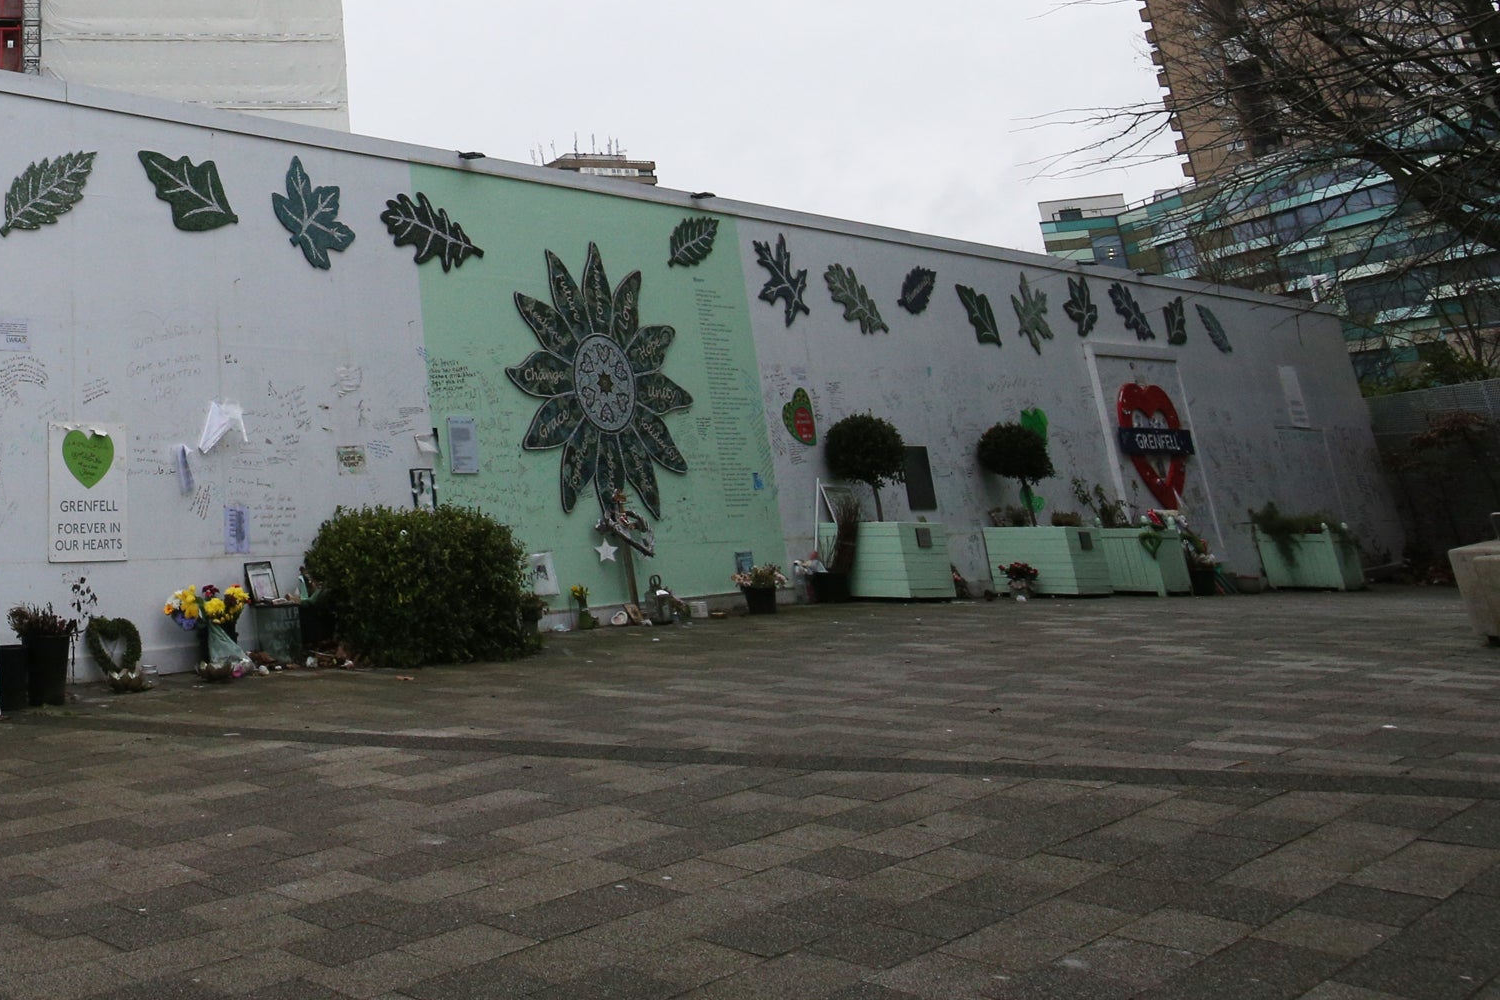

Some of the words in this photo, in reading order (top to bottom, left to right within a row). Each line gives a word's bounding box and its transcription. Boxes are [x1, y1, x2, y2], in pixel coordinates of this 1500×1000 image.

[555, 273, 582, 322] Future
[593, 264, 606, 324] Forever
[619, 290, 635, 331] Love
[639, 338, 662, 360] Hope
[524, 368, 565, 385] Change
[647, 386, 678, 404] Unity
[538, 407, 571, 439] Grace
[1135, 432, 1181, 451] GRENFELL
[60, 500, 119, 513] GRENFELL
[57, 522, 107, 535] FOREVER
[109, 522, 121, 534] IN
[54, 539, 79, 552] OUR
[82, 538, 123, 551] HEARTS
